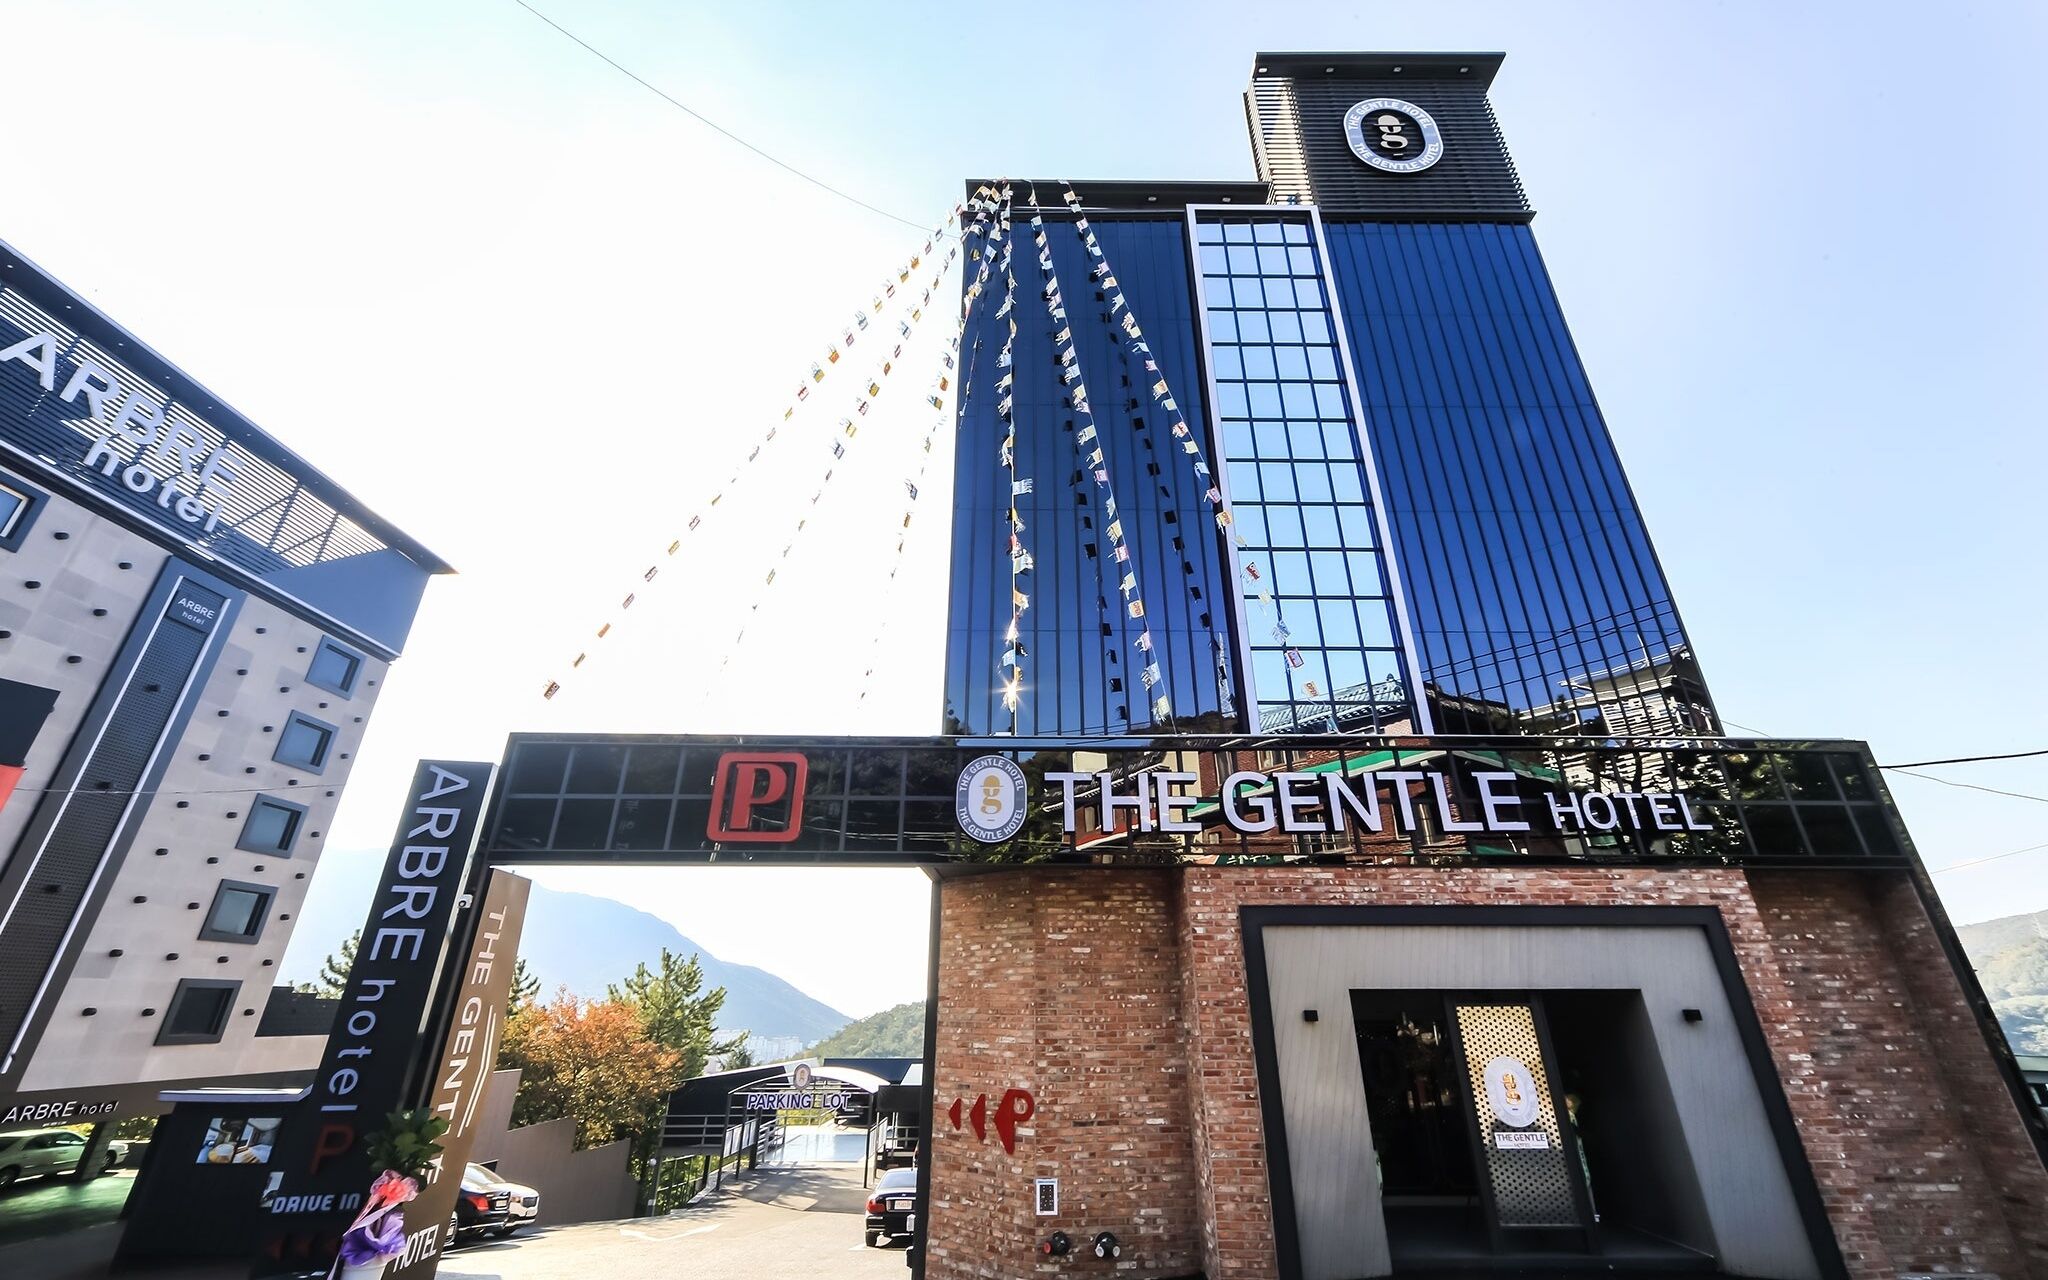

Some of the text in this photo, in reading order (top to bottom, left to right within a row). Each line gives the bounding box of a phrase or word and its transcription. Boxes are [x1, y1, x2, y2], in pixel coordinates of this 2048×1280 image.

[1348, 100, 1433, 130] THE GENTLE HOTEL
[1354, 142, 1440, 171] THE GENTLE HOTEL
[0, 331, 246, 499] ARBRE
[83, 436, 224, 533] hotel
[177, 597, 216, 620] ARBRE
[181, 611, 205, 625] hotel
[958, 757, 1025, 792] THE GENTLE HOTEL
[728, 762, 788, 832] P
[1043, 770, 1714, 834] THE GENTLE HOTEL
[958, 807, 1025, 840] THE GENTLE HOTEL
[320, 764, 471, 1112] ARBRE hotel
[420, 904, 508, 1185] THE GENTE
[1, 1101, 120, 1124] ARBRE hotel
[746, 1092, 852, 1110] PARKING LOT
[309, 1124, 356, 1176] P
[1496, 1133, 1546, 1143] THE GENTLE
[271, 1194, 336, 1214] DRIVE
[392, 1223, 440, 1274] HOTEL
